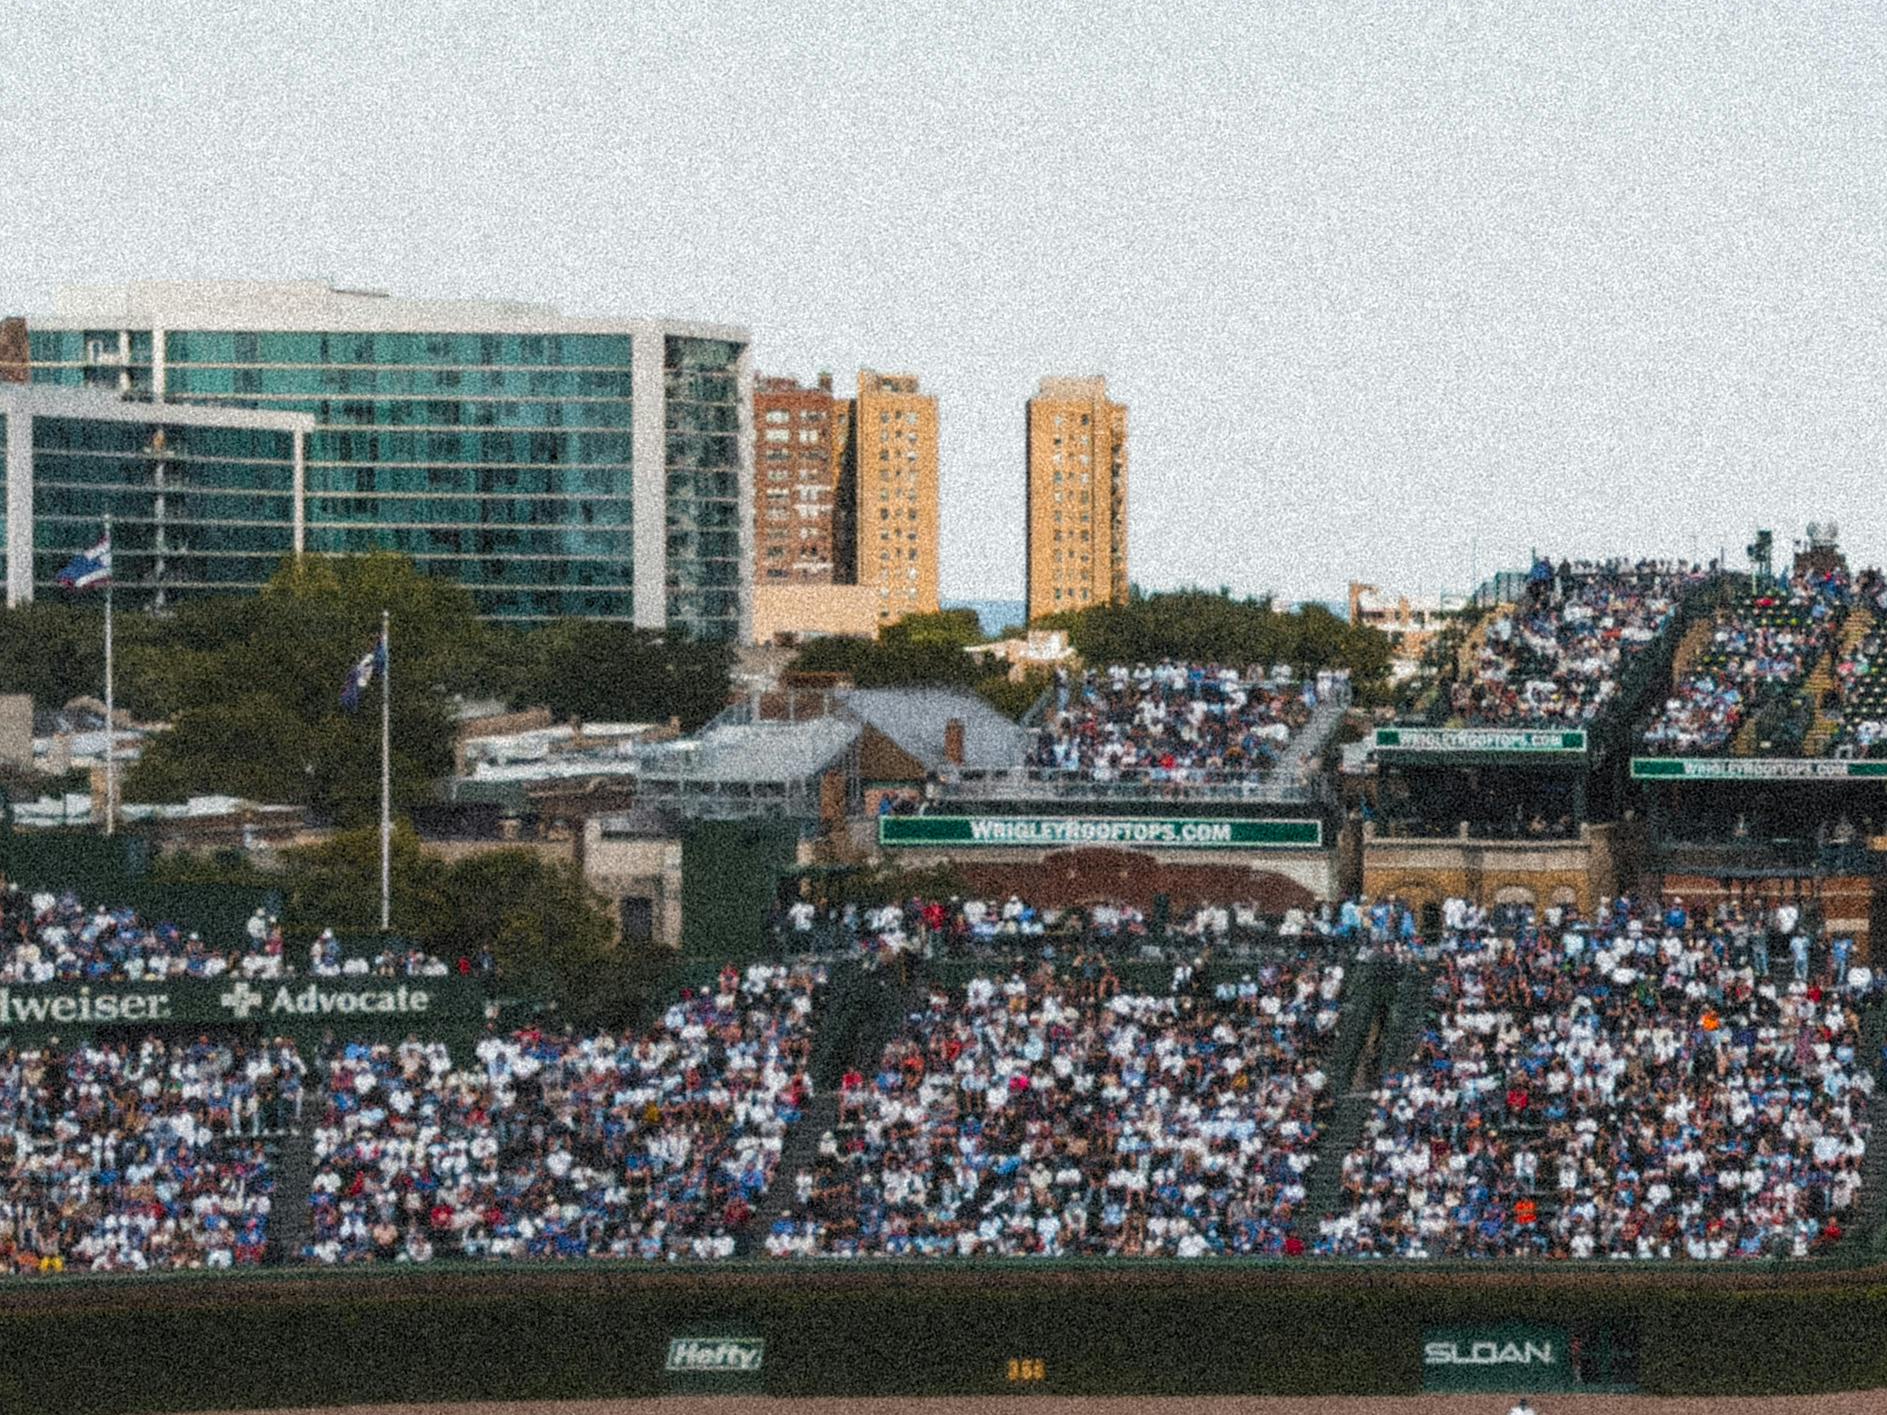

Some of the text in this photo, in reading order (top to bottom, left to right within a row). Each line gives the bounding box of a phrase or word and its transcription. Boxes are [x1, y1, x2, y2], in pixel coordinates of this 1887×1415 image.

[969, 819, 1232, 842] WRIGLEYROOFTOPS.COM
[0, 985, 431, 1022] weiser Advocate
[674, 1342, 758, 1370] Hefty
[1424, 1341, 1552, 1365] SLOAN
